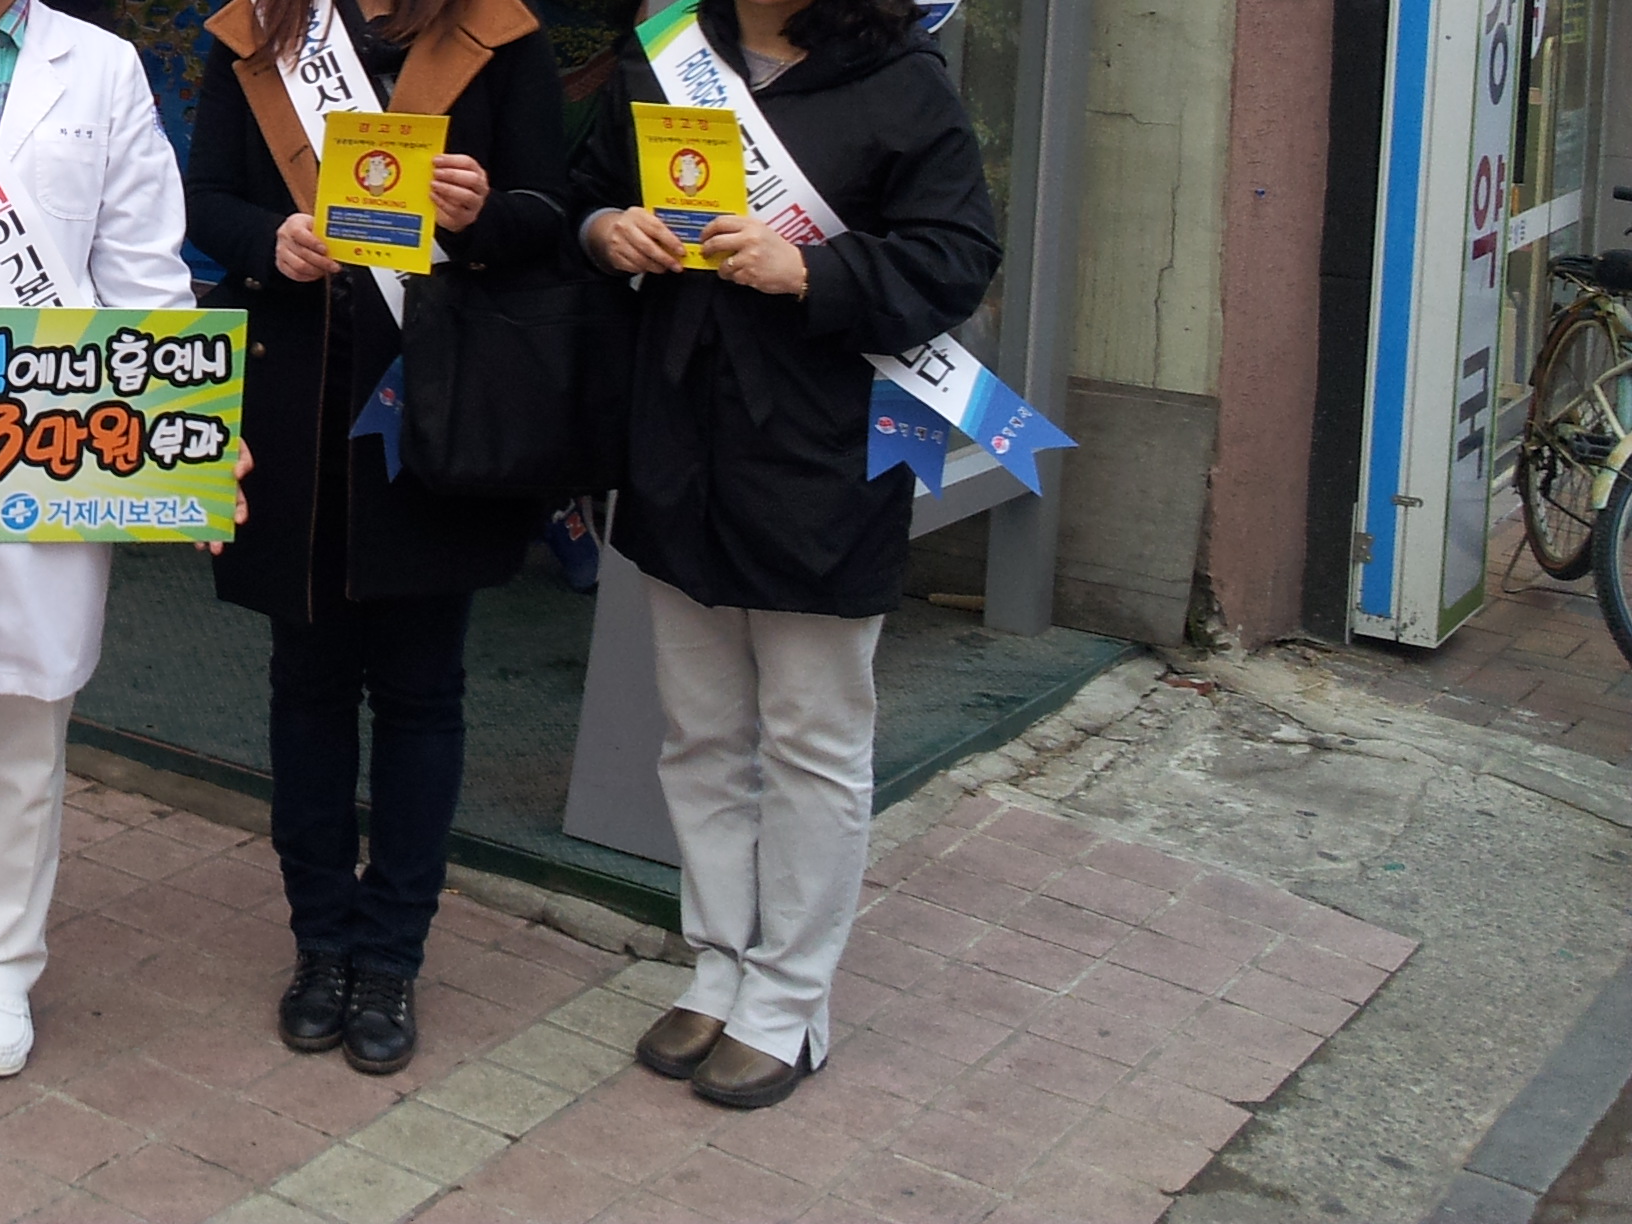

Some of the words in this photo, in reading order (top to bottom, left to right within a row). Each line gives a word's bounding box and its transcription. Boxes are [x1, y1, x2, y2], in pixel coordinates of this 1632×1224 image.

[109, 333, 227, 394] 흡연시
[149, 416, 225, 461] 부과
[46, 498, 207, 529] 거제시보건소
